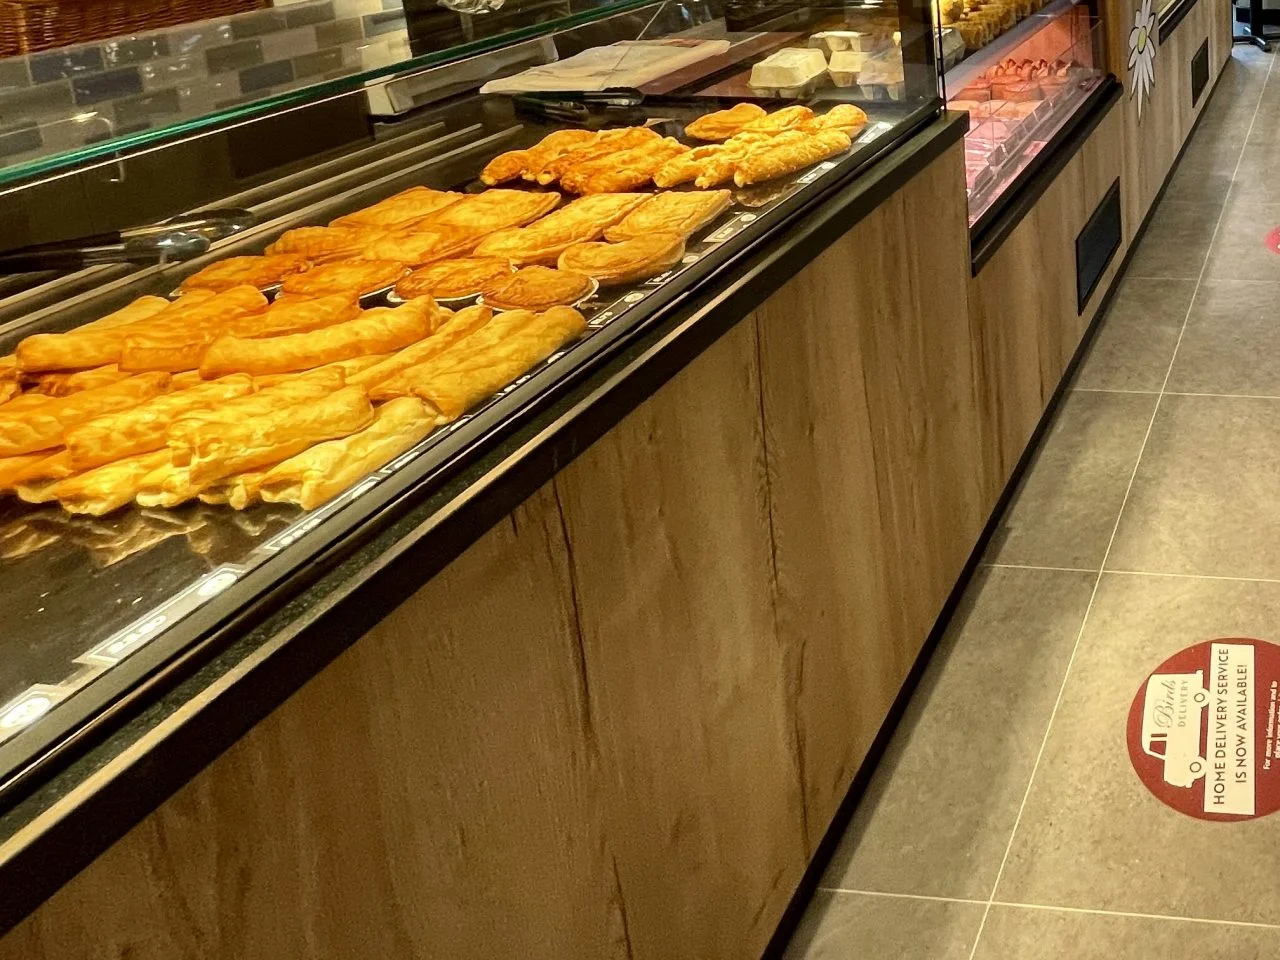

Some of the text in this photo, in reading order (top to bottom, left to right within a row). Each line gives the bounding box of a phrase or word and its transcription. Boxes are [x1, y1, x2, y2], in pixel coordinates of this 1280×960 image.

[1271, 680, 1278, 688] to
[1178, 680, 1189, 727] DELIVERY
[1266, 701, 1276, 738] information
[1213, 648, 1229, 805] HOME DELIVERY SERVICE
[1235, 664, 1248, 784] IS NOW AVAILABLE!
[1263, 758, 1271, 770] For
[1265, 738, 1273, 758] more
